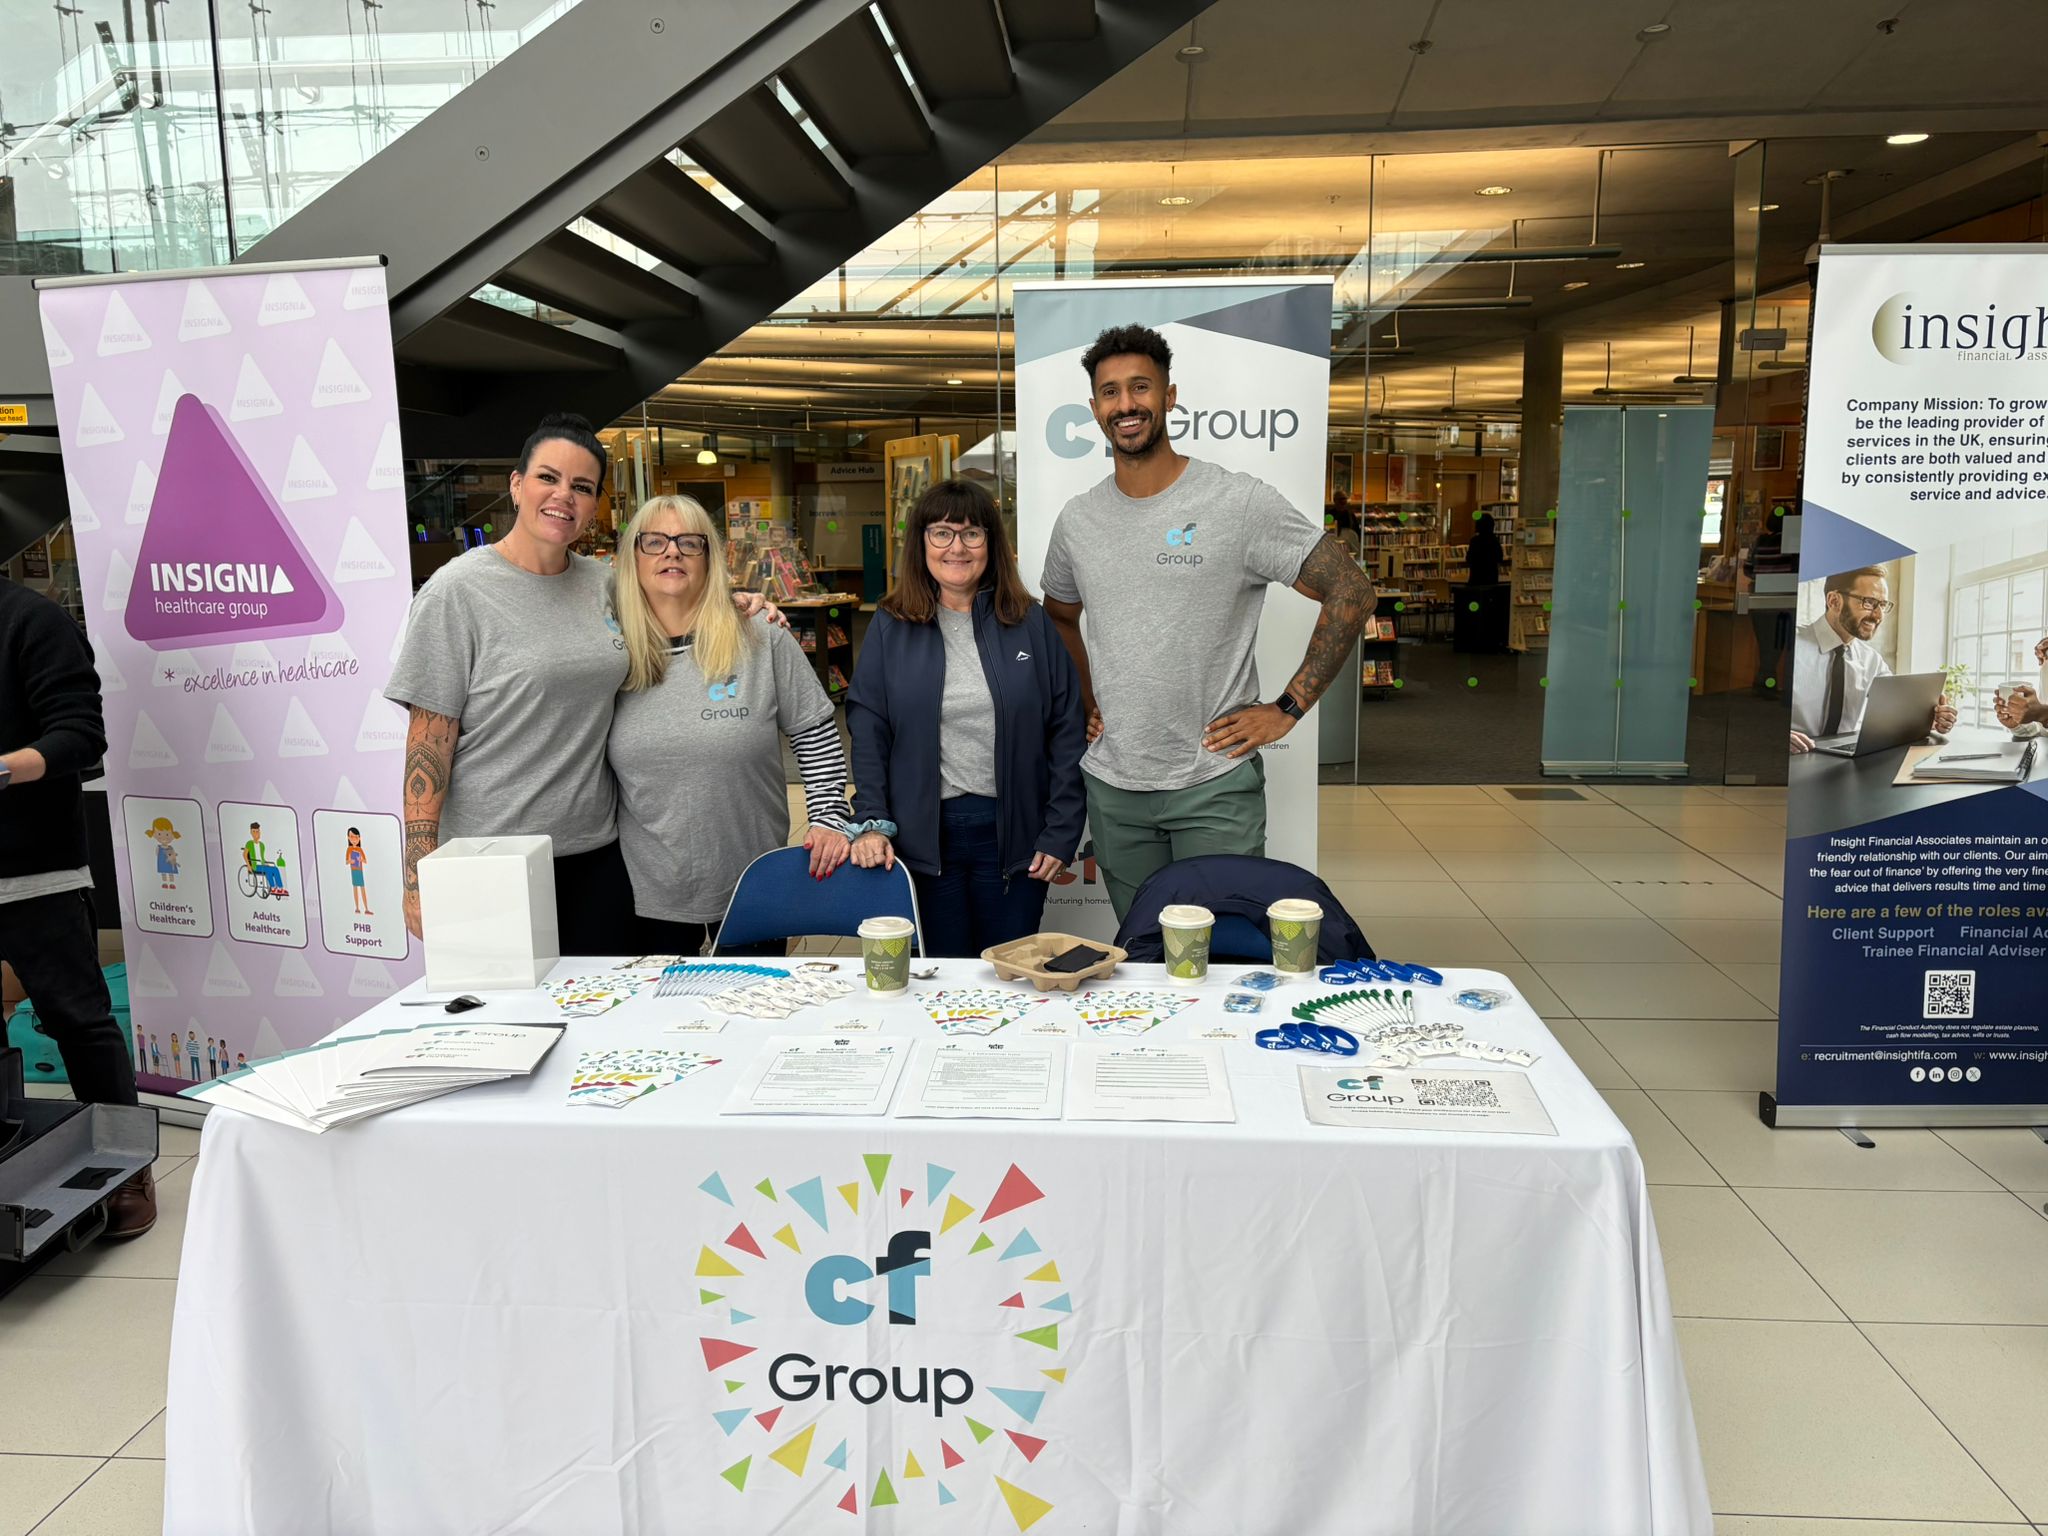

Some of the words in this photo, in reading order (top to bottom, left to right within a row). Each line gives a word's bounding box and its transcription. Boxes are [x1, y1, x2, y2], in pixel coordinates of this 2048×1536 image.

[1846, 398, 1919, 415] Company
[1923, 397, 1984, 412] Mission:
[1988, 397, 2005, 410] To
[2009, 400, 2047, 413] grow
[1046, 403, 1113, 459] c
[1855, 417, 1874, 430] be
[1879, 417, 1902, 430] the
[1907, 416, 1959, 433] leading
[1963, 415, 2024, 432] provider
[2029, 415, 2044, 428] of
[1846, 435, 1910, 448] services
[1915, 434, 1928, 447] in
[1933, 434, 1955, 447] the
[1960, 434, 1984, 448] UK,
[1988, 433, 2048, 448] ensurin
[1846, 452, 1897, 466] clients
[1901, 455, 1924, 465] are
[1928, 452, 1960, 465] both
[1965, 452, 2012, 464] valued
[2017, 451, 2046, 463] and
[830, 466, 857, 474] Advice
[858, 466, 875, 474] Hub
[1841, 471, 1860, 486] by
[1865, 471, 1954, 485] consistently
[1958, 470, 2028, 485] providing
[1910, 488, 1961, 501] service
[1965, 487, 1992, 500] and
[1166, 522, 1197, 546] cf
[1156, 552, 1203, 567] Group
[155, 597, 225, 616] healthcare
[229, 601, 268, 620] group
[183, 669, 258, 693] excellence
[262, 666, 276, 683] in
[278, 657, 359, 684] healthcare
[707, 674, 739, 702] cf
[701, 706, 749, 721] Group
[1830, 837, 1866, 849] Insight
[1868, 836, 1914, 847] Financial
[1915, 836, 1972, 846] Associates
[1975, 836, 2021, 846] maintain
[1817, 852, 1856, 864] friendly
[1859, 851, 1917, 863] relationship
[1920, 851, 1940, 861] with
[1943, 852, 1961, 860] our
[1963, 850, 2001, 860] clients.
[2005, 850, 2026, 860] Our
[1809, 867, 1828, 878] the
[1830, 867, 1852, 877] fear
[1854, 868, 1871, 877] out
[1873, 867, 1883, 877] of
[1885, 867, 1925, 877] finance'
[1926, 867, 1940, 879] by
[1942, 866, 1982, 879] offering
[1985, 866, 2002, 876] the
[2005, 868, 2028, 878] very
[1835, 883, 1868, 893] advice
[1871, 882, 1890, 892] that
[1892, 882, 1932, 892] delivers
[1935, 882, 1969, 892] results
[1973, 882, 1996, 891] time
[1999, 882, 2020, 891] and
[2023, 881, 2046, 891] time
[149, 901, 194, 914] Children's
[1045, 897, 1083, 906] Nurturing
[252, 911, 281, 923] Adults
[1807, 905, 1847, 919] Here
[1851, 908, 1876, 919] are
[1880, 909, 1889, 918] a
[1894, 905, 1921, 918] few
[1926, 904, 1943, 918] of
[1947, 904, 1974, 917] the
[1979, 904, 2021, 917] roles
[2026, 907, 2048, 917] av
[149, 913, 197, 927] Healthcare
[245, 922, 291, 937] Healthcare
[353, 923, 372, 933] PHB
[1832, 927, 1874, 940] Client
[1878, 926, 1935, 941] Support
[1960, 926, 2029, 939] Financial
[345, 934, 383, 948] Support
[1862, 945, 1914, 958] Trainee
[1918, 944, 1984, 957] Financial
[1988, 944, 2046, 956] Adviser
[1814, 1050, 1958, 1062] recruitment@insightifa.com
[1337, 1075, 1384, 1091] cf
[1326, 1093, 1404, 1106] Group
[804, 1230, 931, 1326] cf
[768, 1352, 974, 1418] Group
